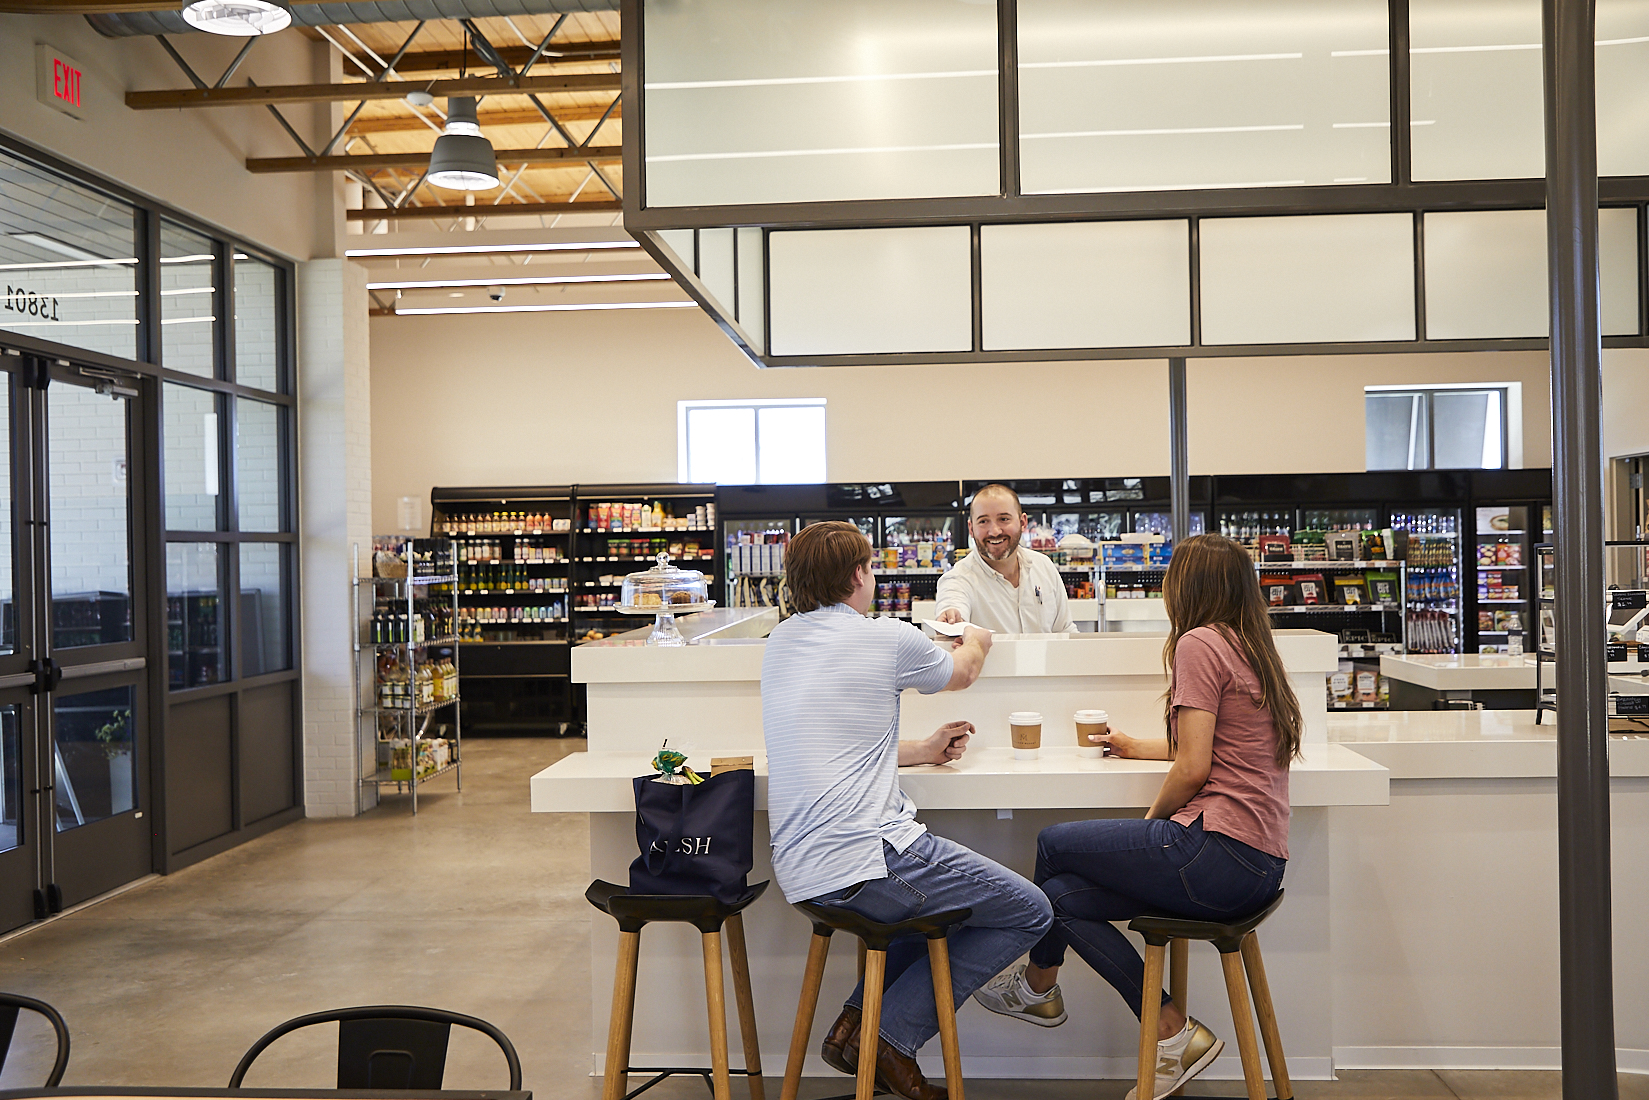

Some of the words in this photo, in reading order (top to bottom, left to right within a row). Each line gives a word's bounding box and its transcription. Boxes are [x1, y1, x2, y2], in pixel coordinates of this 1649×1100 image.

[54, 58, 82, 108] EXIT
[1000, 990, 1023, 1008] N
[1155, 1057, 1179, 1076] N
